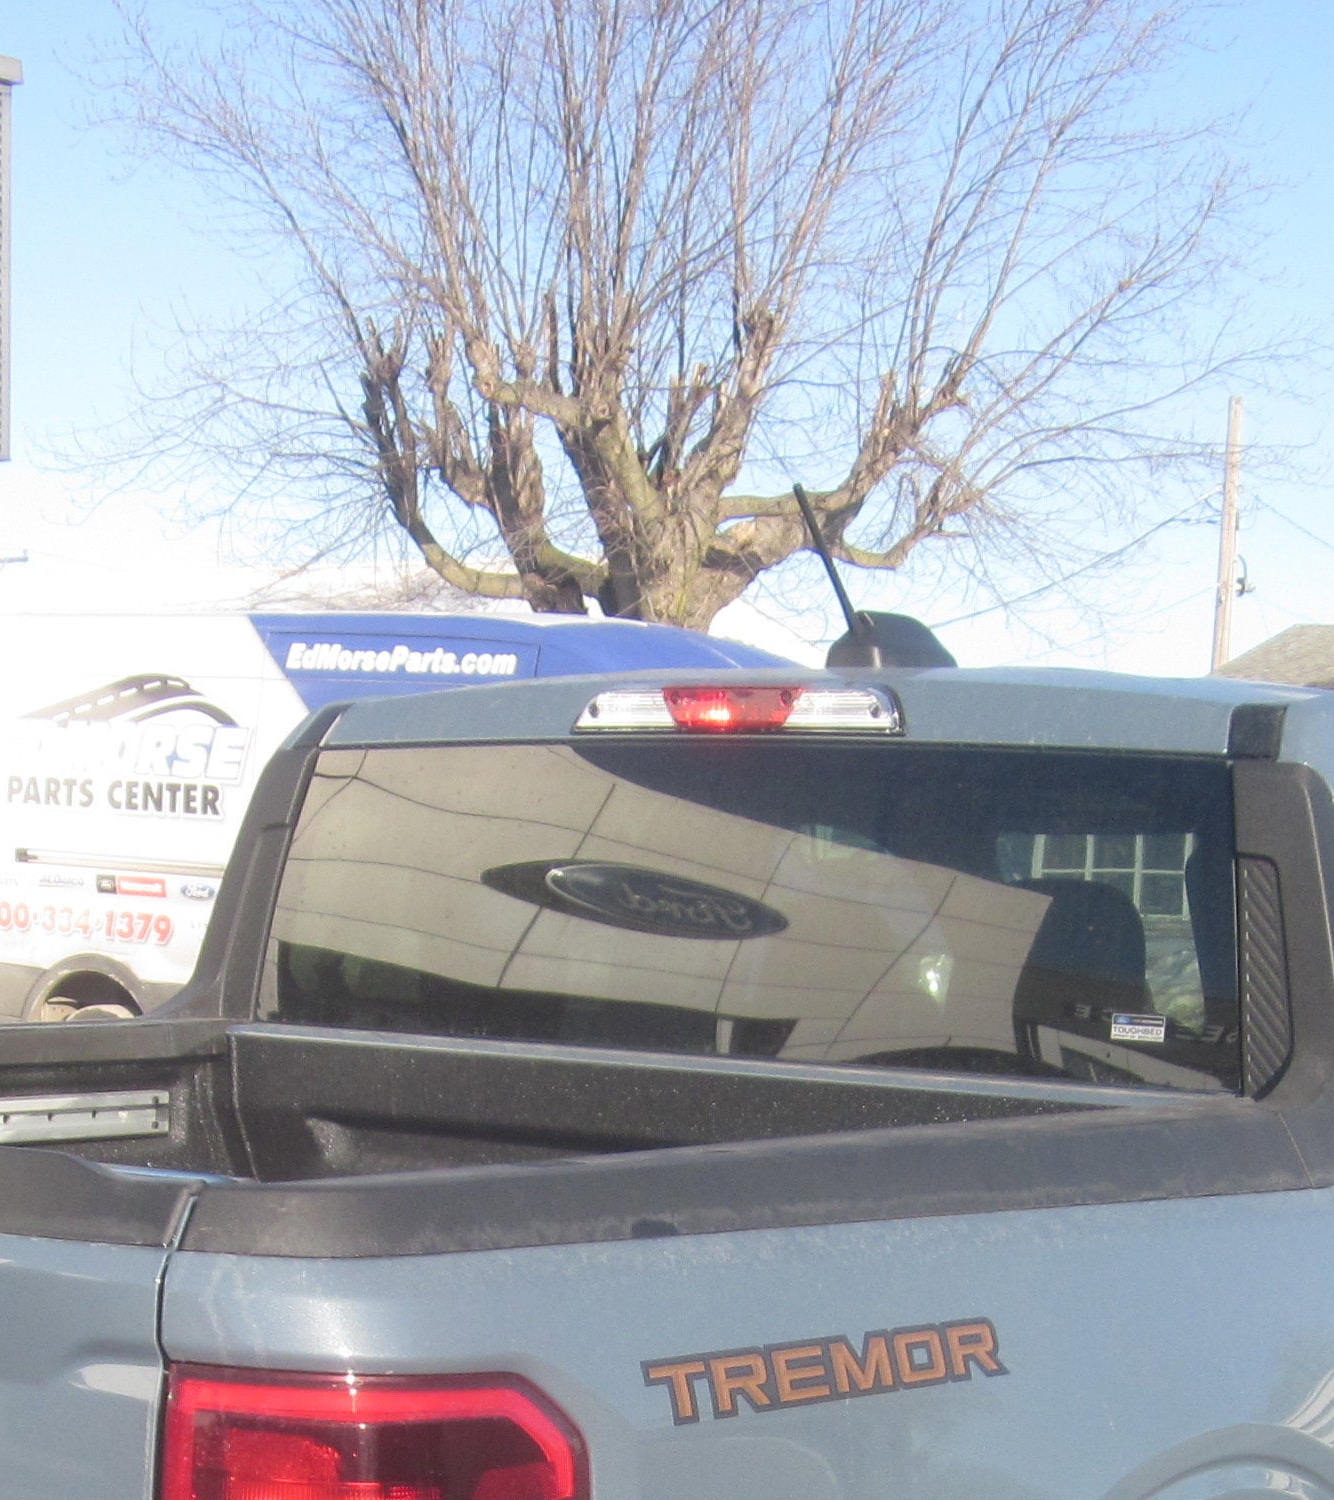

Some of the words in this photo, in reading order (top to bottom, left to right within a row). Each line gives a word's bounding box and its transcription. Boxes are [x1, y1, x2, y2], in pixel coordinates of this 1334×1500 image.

[285, 642, 517, 676] EdMorseParts.com
[7, 775, 95, 808] PARTS
[107, 779, 221, 816] CENTER
[640, 1316, 1010, 1427] TREMOR
